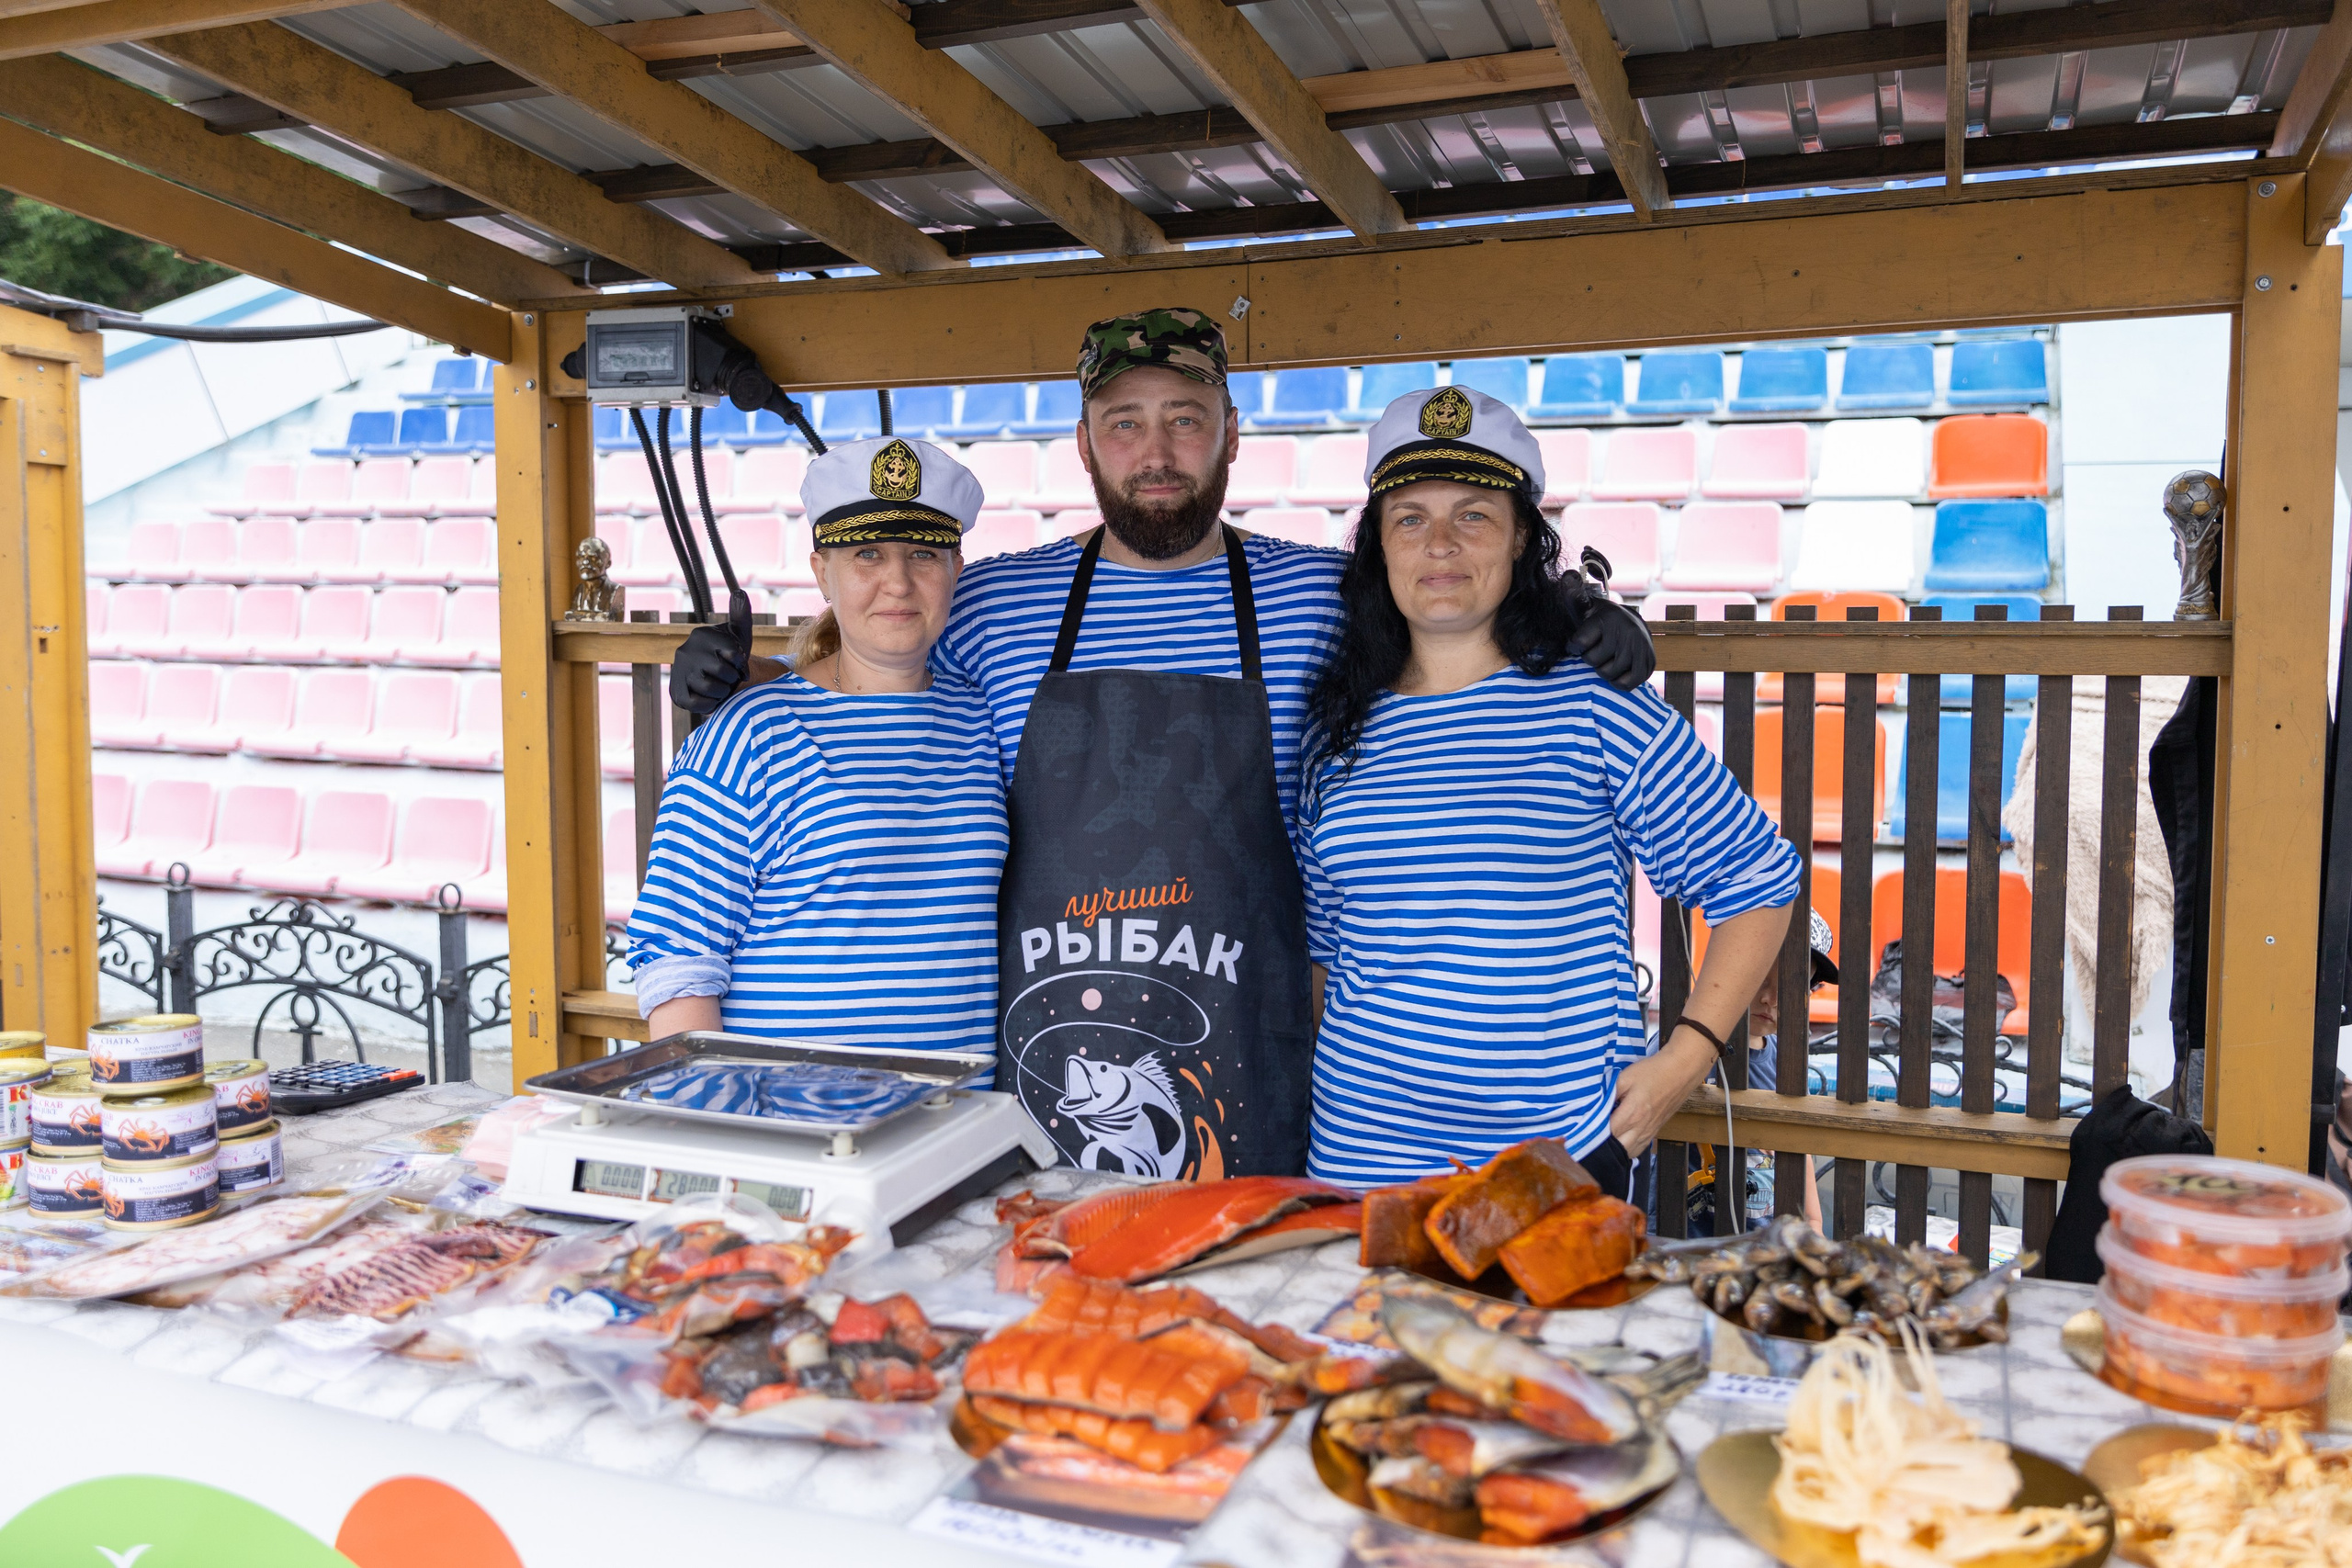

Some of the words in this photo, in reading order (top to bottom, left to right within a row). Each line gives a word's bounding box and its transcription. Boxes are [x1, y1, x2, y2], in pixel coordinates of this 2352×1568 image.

[1427, 426, 1457, 435] CAPTAIN
[876, 487, 910, 498] CAPTAIN
[1065, 876, 1193, 928] лучший
[1021, 918, 1244, 985] РЫБАК
[101, 1037, 140, 1045] CHATKA
[189, 1165, 211, 1177] KING
[108, 1175, 143, 1184] CHATKA
